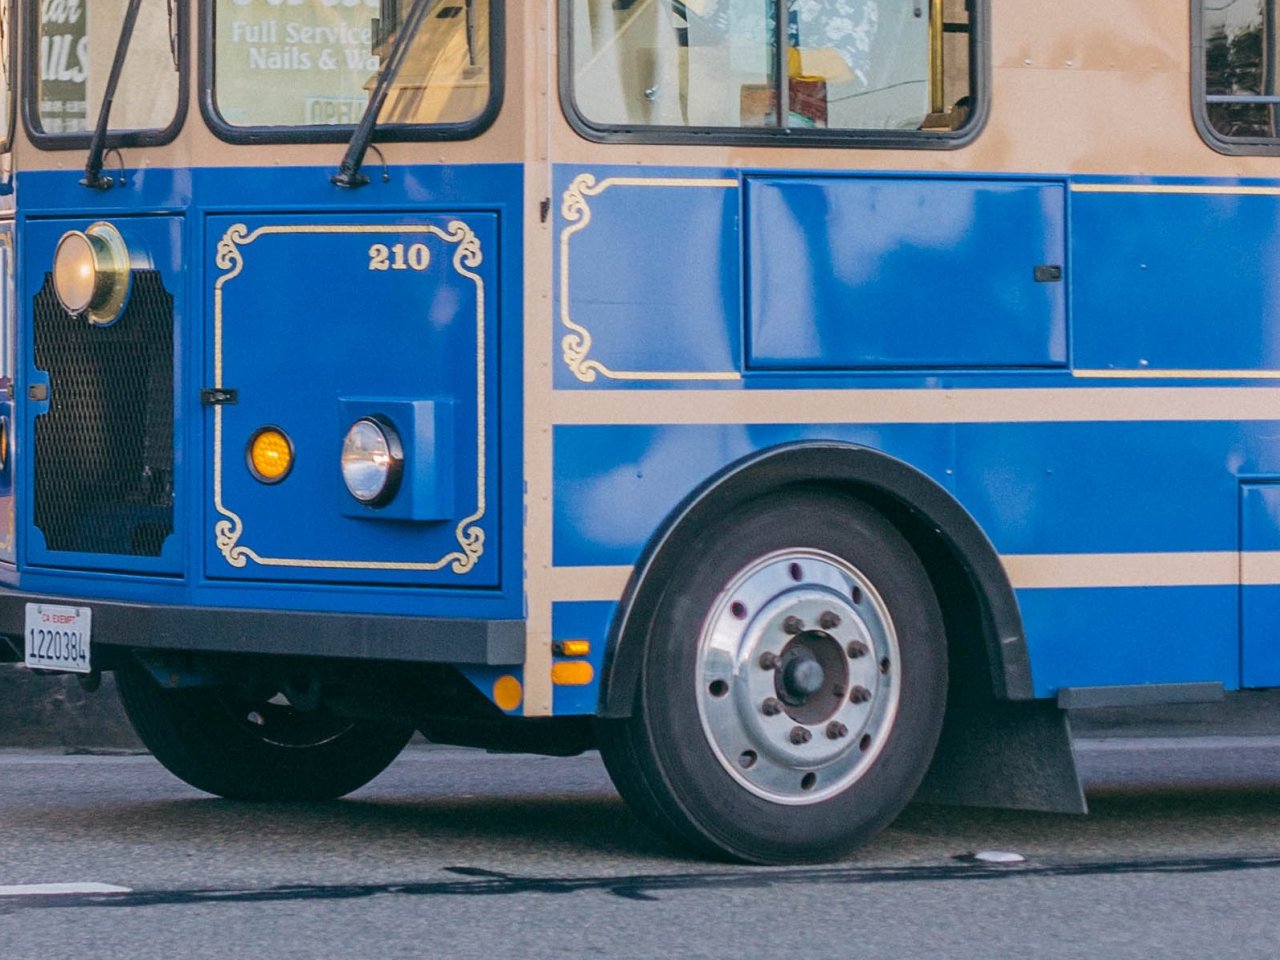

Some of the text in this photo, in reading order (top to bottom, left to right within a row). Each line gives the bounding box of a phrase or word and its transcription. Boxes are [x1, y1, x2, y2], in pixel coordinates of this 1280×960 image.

[233, 20, 372, 45] Full Service
[248, 47, 311, 70] Nails
[318, 48, 338, 70] &
[368, 243, 431, 271] 210
[29, 628, 87, 663] 1220384
